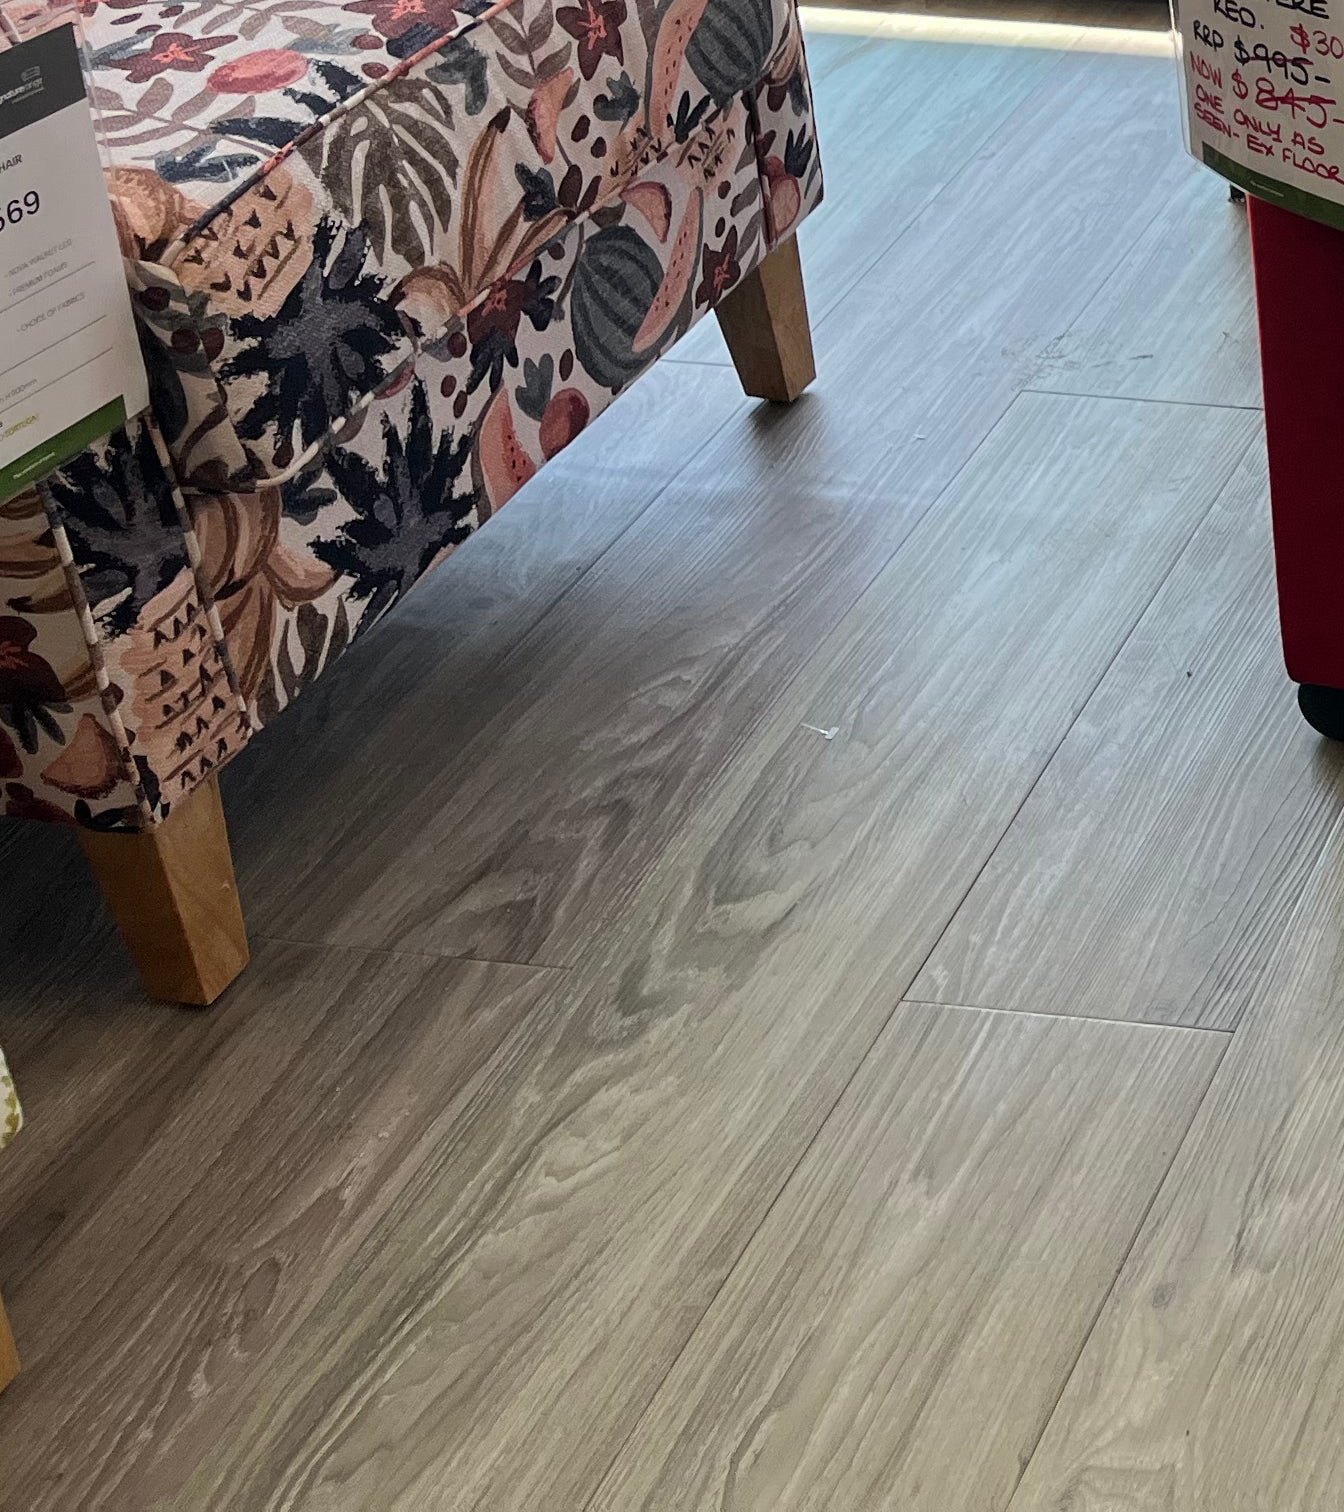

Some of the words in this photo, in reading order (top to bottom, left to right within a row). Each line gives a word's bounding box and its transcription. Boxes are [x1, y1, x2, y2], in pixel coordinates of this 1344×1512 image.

[1193, 19, 1224, 52] RRP
[1190, 51, 1222, 89] NOW
[1196, 84, 1225, 114] ONE
[1233, 108, 1282, 143] ONLY
[1291, 131, 1324, 155] AS
